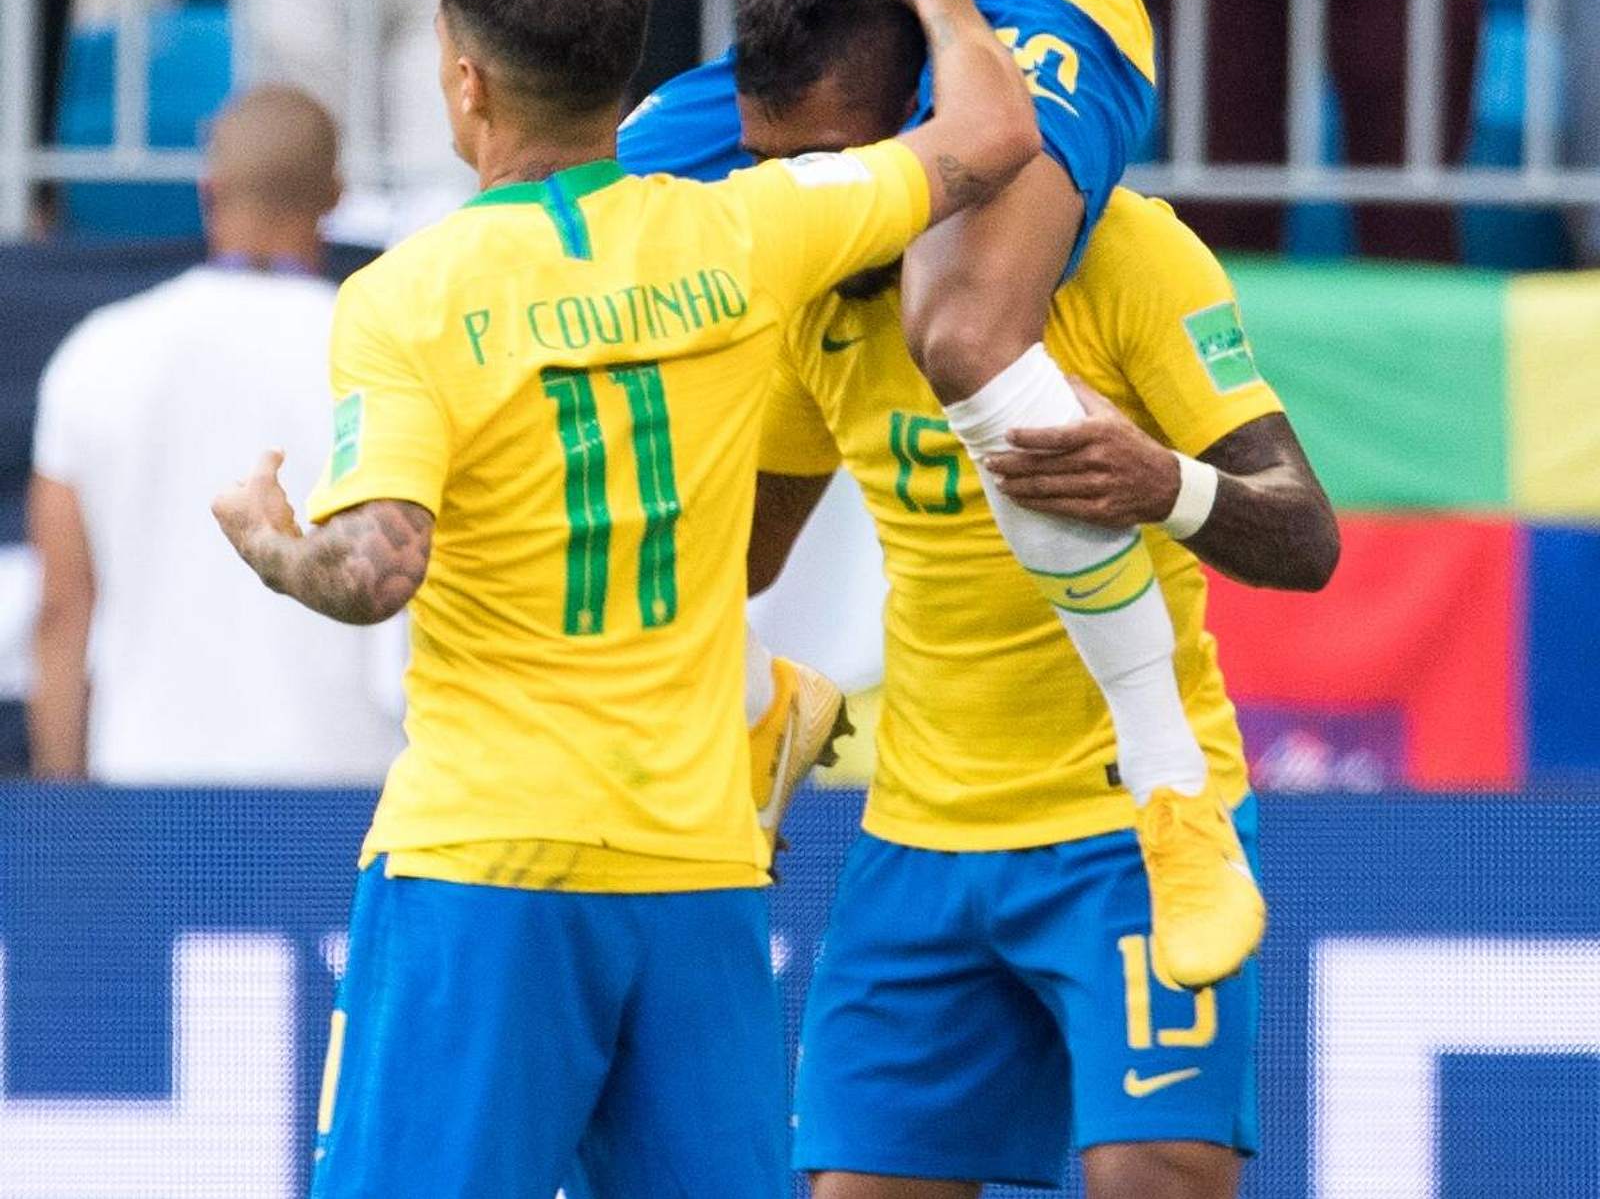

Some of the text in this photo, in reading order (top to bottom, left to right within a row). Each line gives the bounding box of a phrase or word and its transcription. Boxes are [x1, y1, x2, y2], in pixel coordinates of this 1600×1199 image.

[527, 268, 747, 350] COUTINHO
[540, 359, 682, 636] 11
[890, 410, 963, 515] 15
